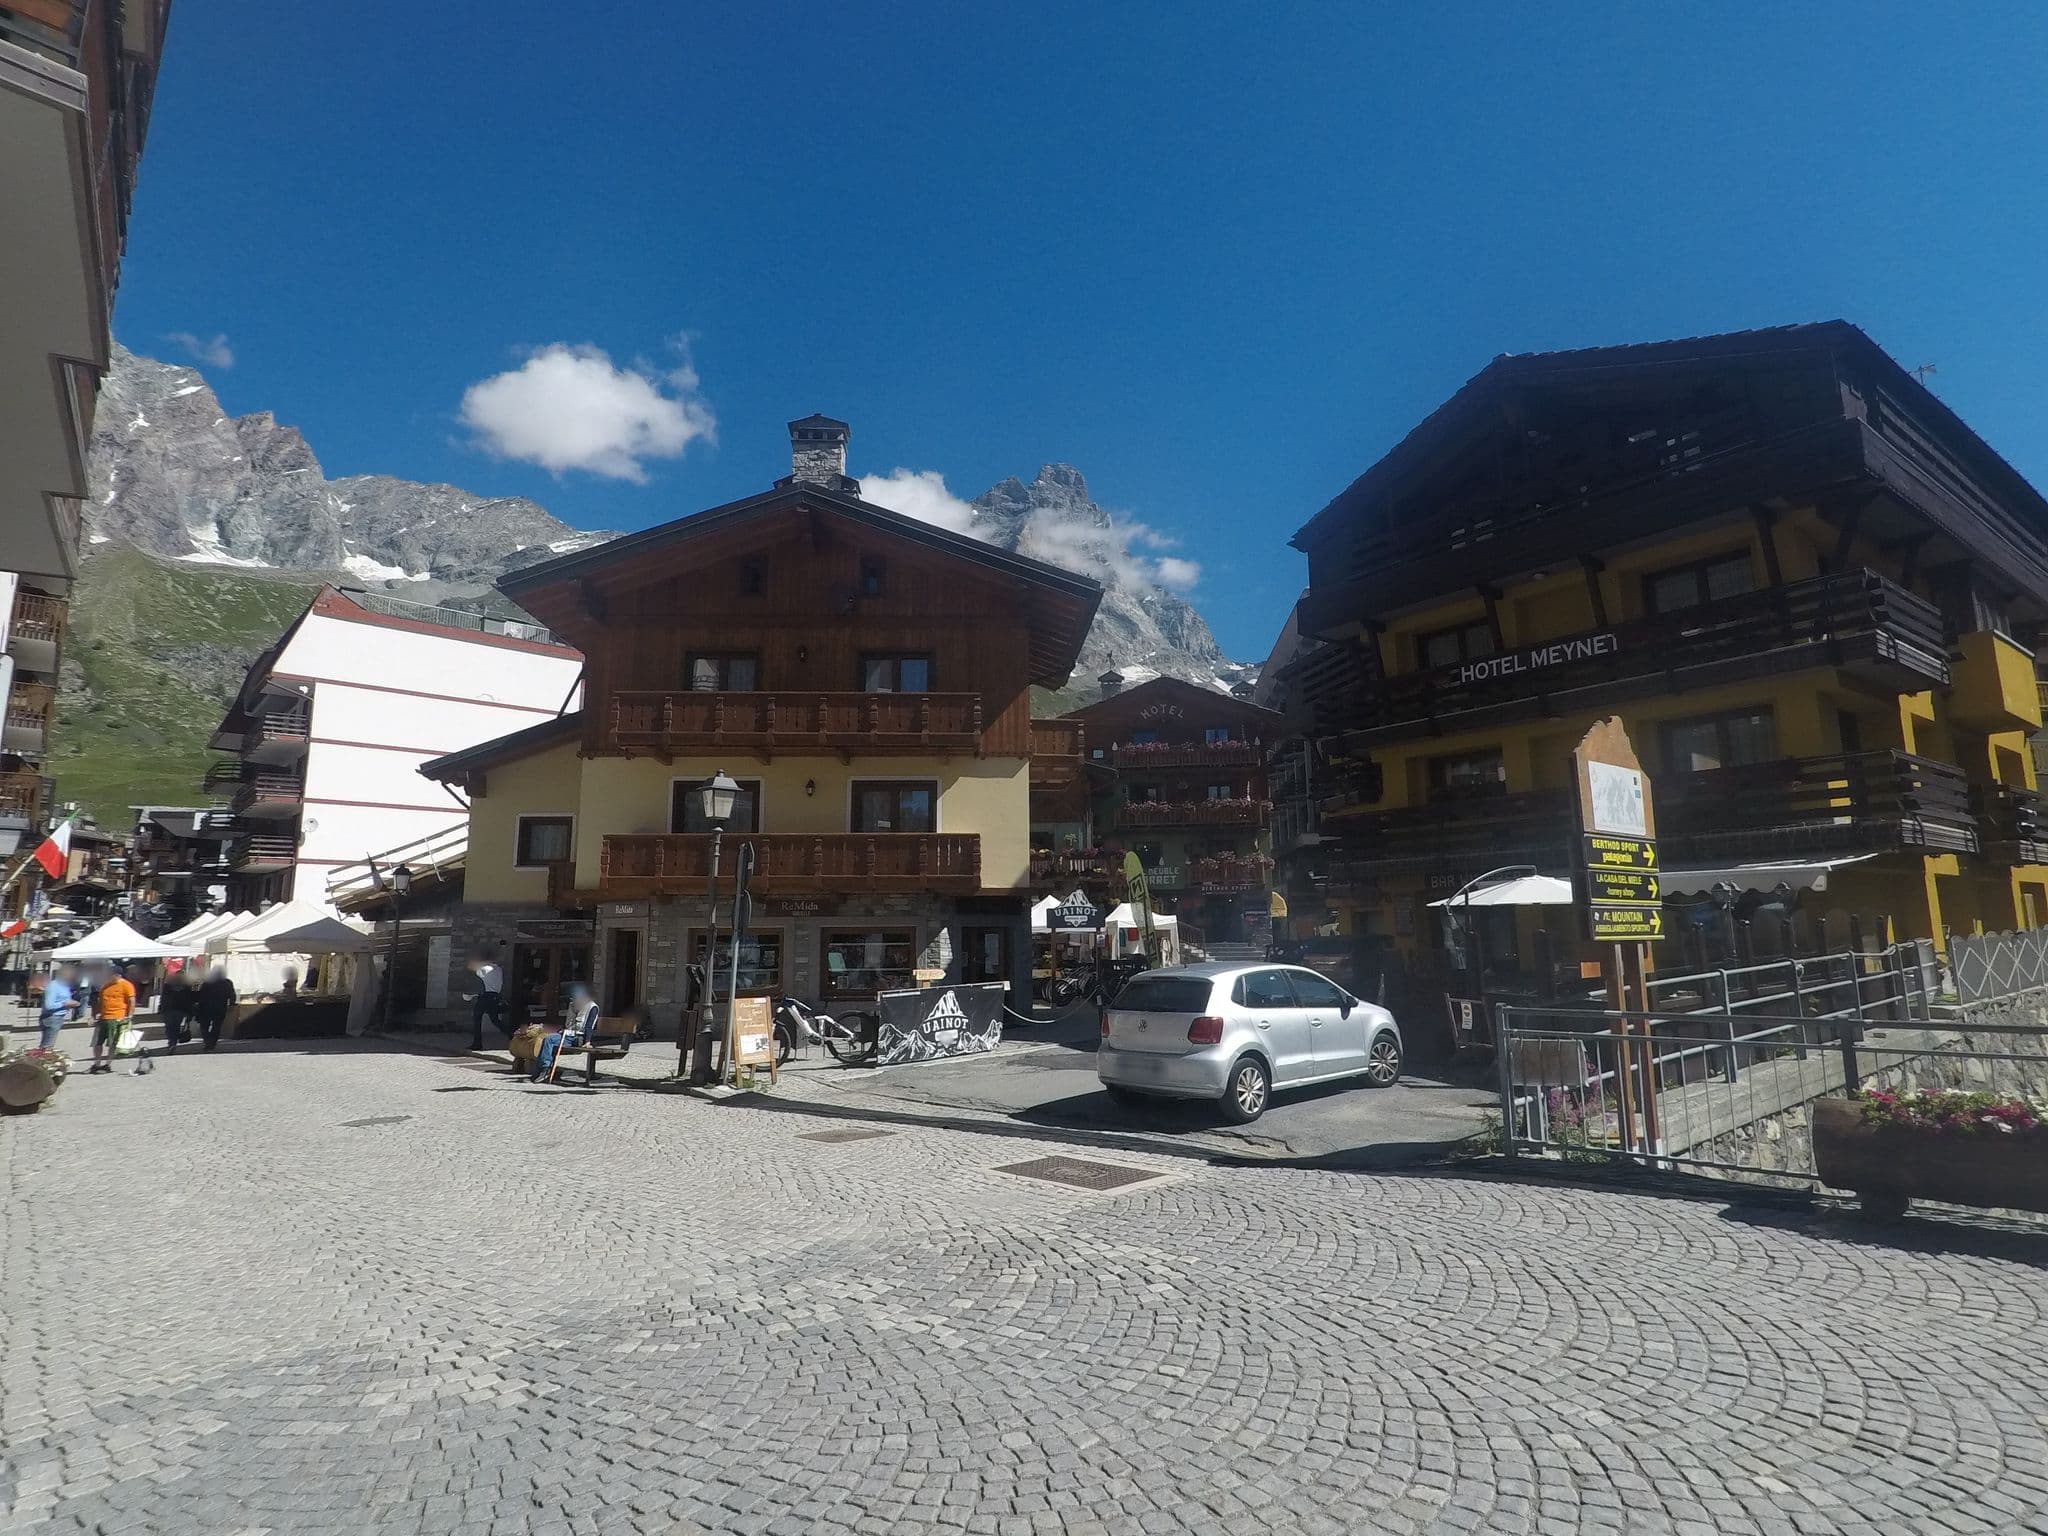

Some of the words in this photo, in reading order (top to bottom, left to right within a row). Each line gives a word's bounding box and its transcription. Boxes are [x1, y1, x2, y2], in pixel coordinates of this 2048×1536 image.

[1460, 655, 1527, 683] HOTEL
[1531, 632, 1619, 669] MEYNET
[1140, 703, 1185, 720] HOTEL
[1592, 838, 1620, 850] BERTHOD
[1621, 841, 1639, 852] SPORT
[1596, 873, 1604, 882] LA
[780, 900, 819, 911] ReMida
[1054, 907, 1098, 917] UAINOT
[1611, 911, 1643, 922] MOUNTAIN
[922, 1017, 969, 1034] UAINOT
